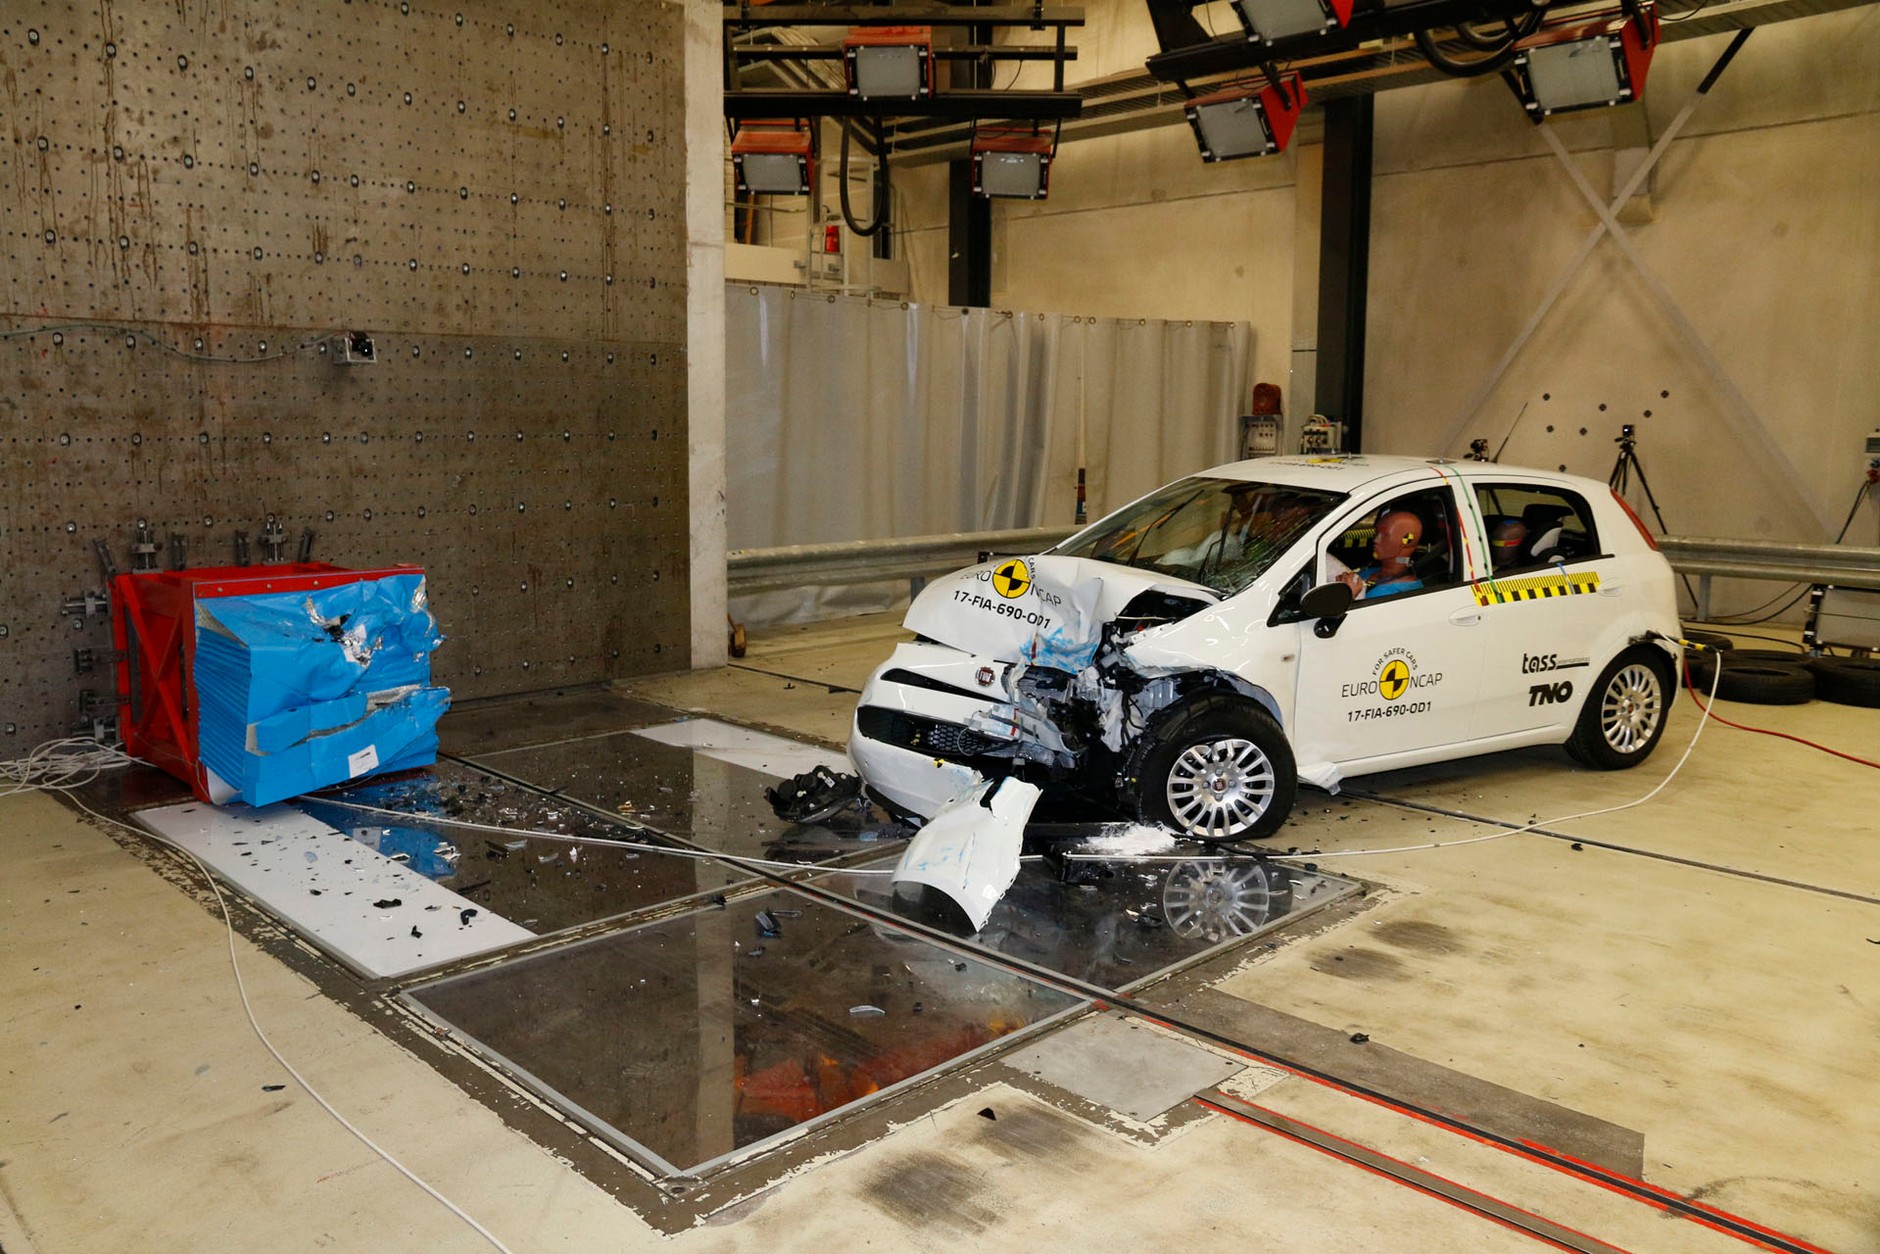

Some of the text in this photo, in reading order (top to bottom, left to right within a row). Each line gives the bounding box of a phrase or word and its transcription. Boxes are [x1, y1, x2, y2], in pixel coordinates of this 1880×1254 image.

[1030, 584, 1062, 607] NCAP
[1372, 647, 1418, 675] FOR SAFER CARS
[1522, 653, 1557, 674] tass
[1341, 673, 1443, 698] EURO NCAP
[1528, 680, 1573, 707] TNO
